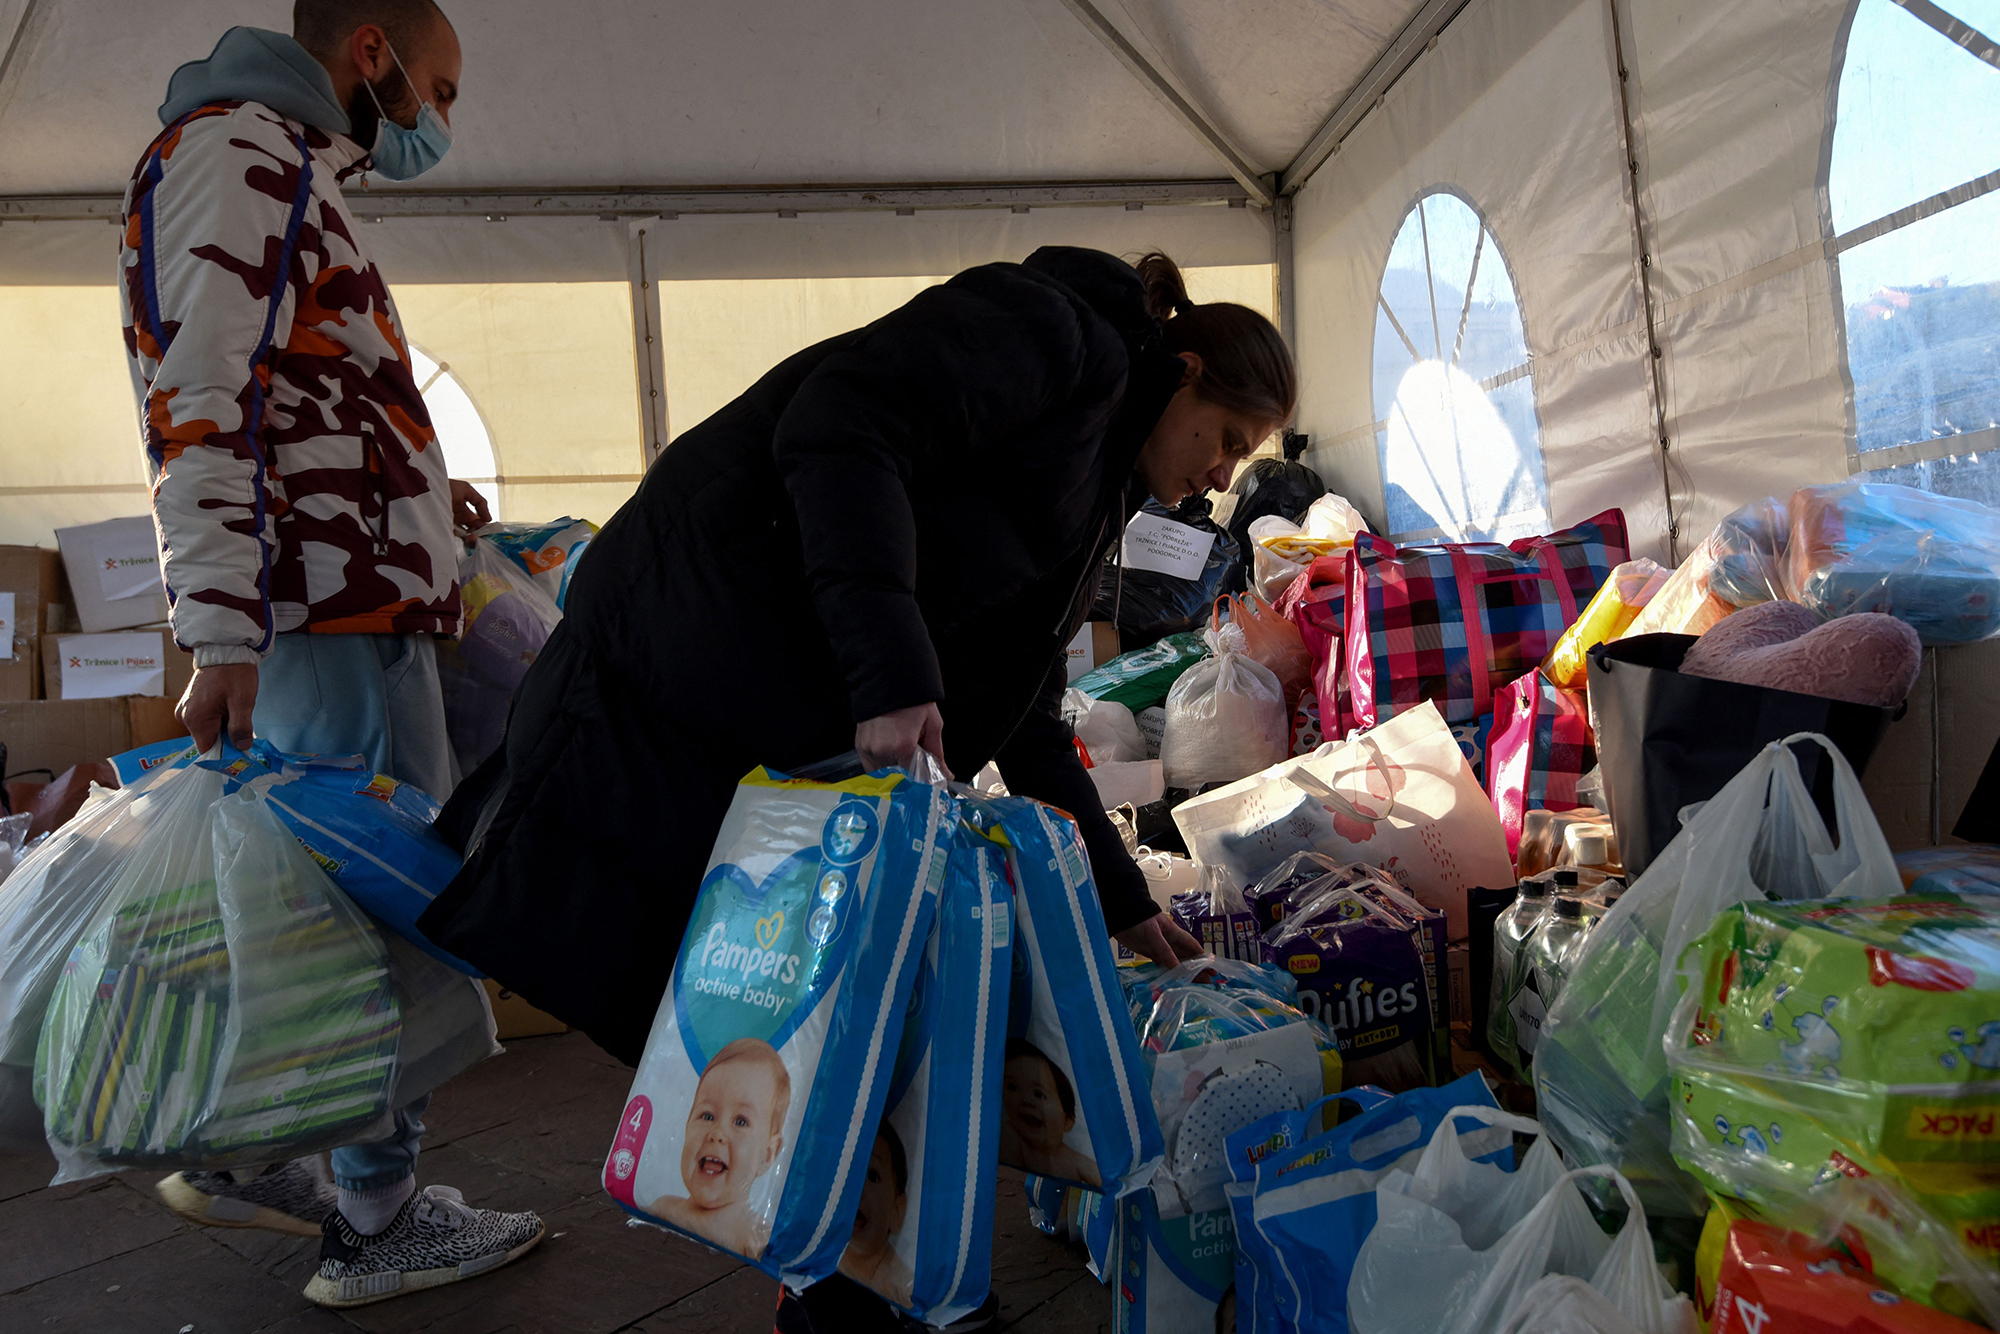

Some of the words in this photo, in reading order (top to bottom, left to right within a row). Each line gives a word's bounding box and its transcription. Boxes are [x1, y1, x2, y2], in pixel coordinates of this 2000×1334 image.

[1162, 526, 1185, 536] ZAKUPCI
[1136, 537, 1157, 545] TRŽNICE
[1147, 548, 1181, 560] PODGORICA
[120, 557, 154, 566] Tržnice
[488, 619, 518, 643] double
[84, 657, 119, 666] Tržnice
[126, 657, 155, 667] Pijace
[701, 921, 800, 984] Pampers
[1290, 958, 1319, 970] NEW
[694, 976, 741, 1000] active
[742, 982, 786, 1016] baby
[1339, 1038, 1352, 1051] BY
[629, 1106, 644, 1132] 4
[1921, 1113, 1994, 1135] PACK
[619, 1162, 630, 1174] 58
[1192, 1239, 1233, 1258] activ
[1734, 1294, 1772, 1334] 4
